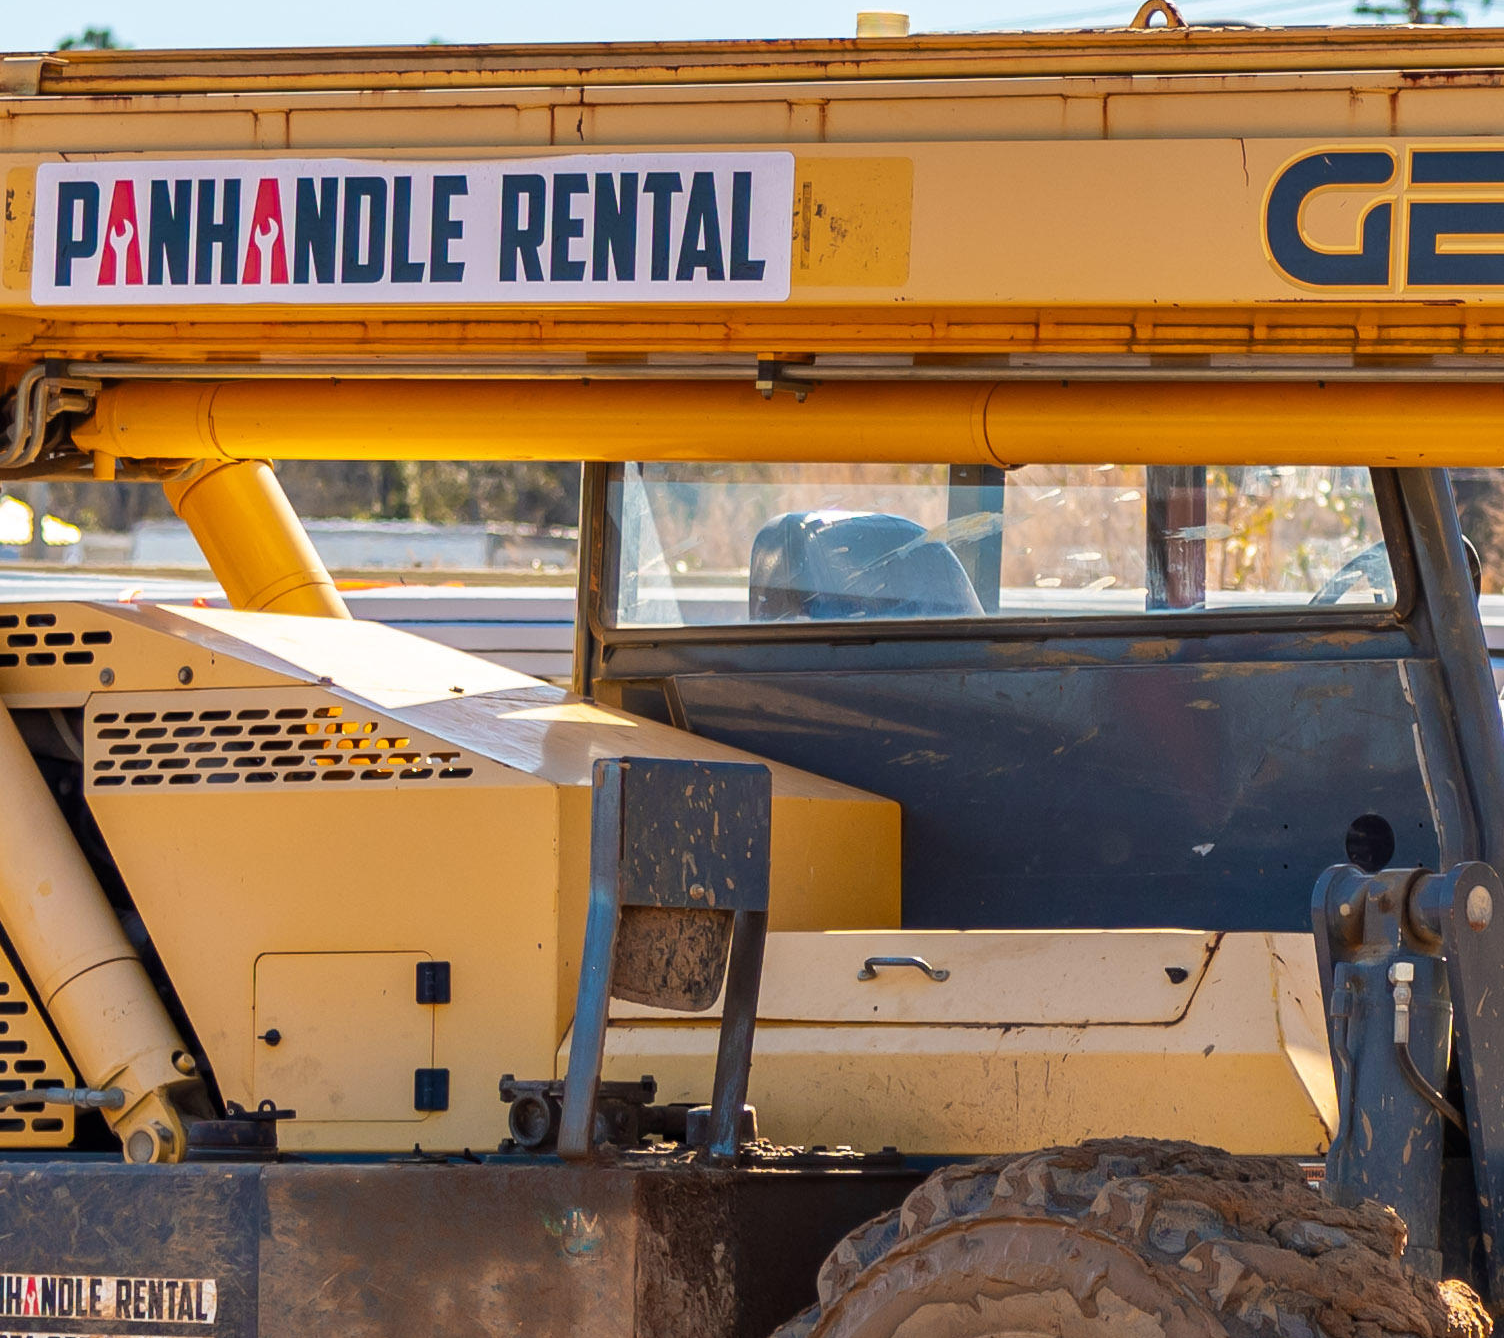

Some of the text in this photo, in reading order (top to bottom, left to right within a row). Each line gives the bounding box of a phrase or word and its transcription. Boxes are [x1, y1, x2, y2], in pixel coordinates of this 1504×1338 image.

[54, 170, 766, 287] PANHANDLE RENTAL
[115, 1278, 208, 1322] RENTAL
